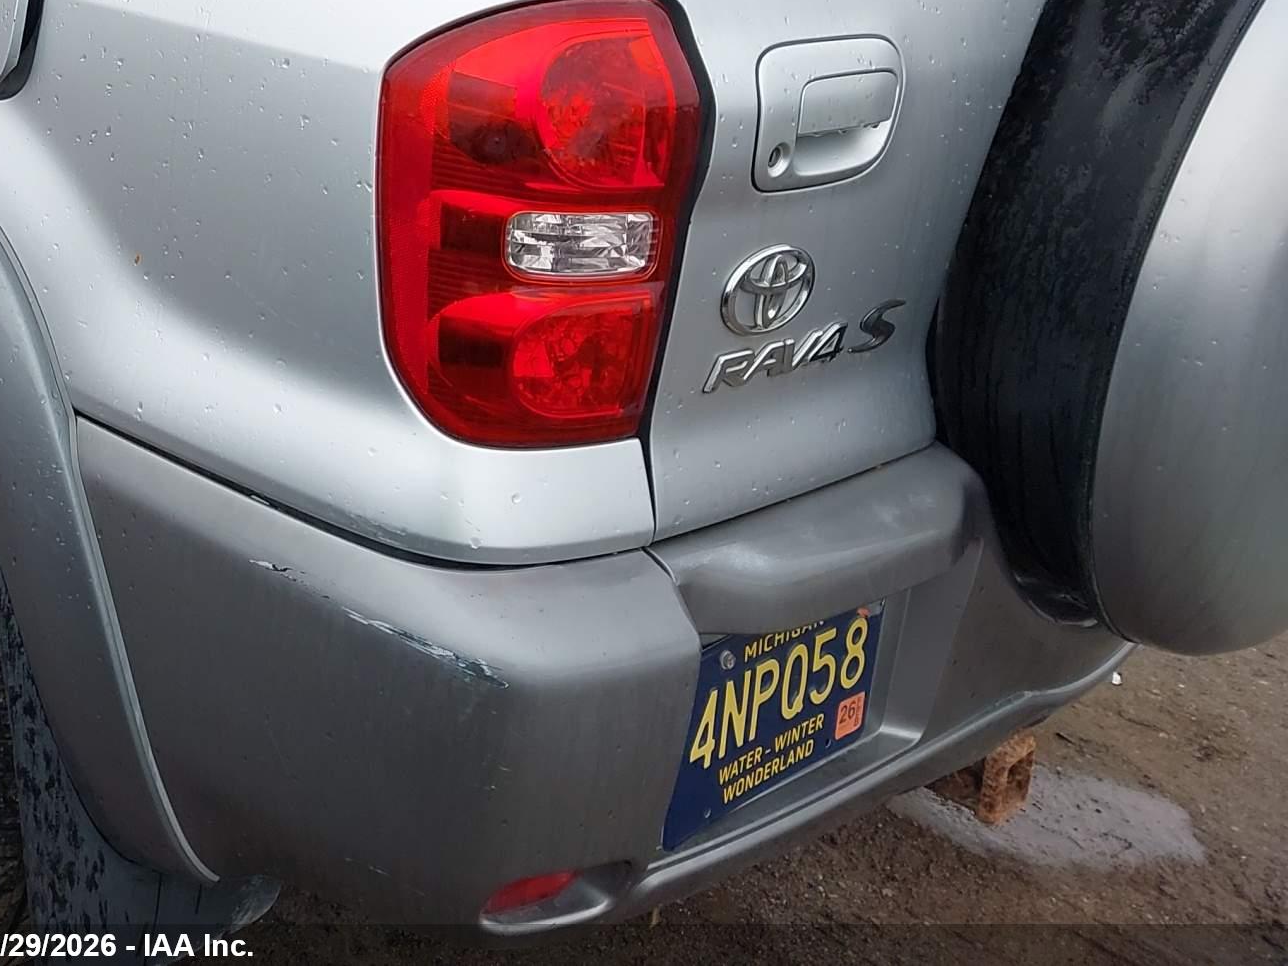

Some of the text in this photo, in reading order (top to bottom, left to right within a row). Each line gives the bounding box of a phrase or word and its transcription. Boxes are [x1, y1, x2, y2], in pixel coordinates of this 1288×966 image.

[702, 299, 906, 394] RAV4 S
[689, 617, 868, 769] 4NPQ58
[719, 746, 763, 785] WATER
[774, 713, 824, 752] WINTER
[723, 739, 814, 804] WONDERLAND
